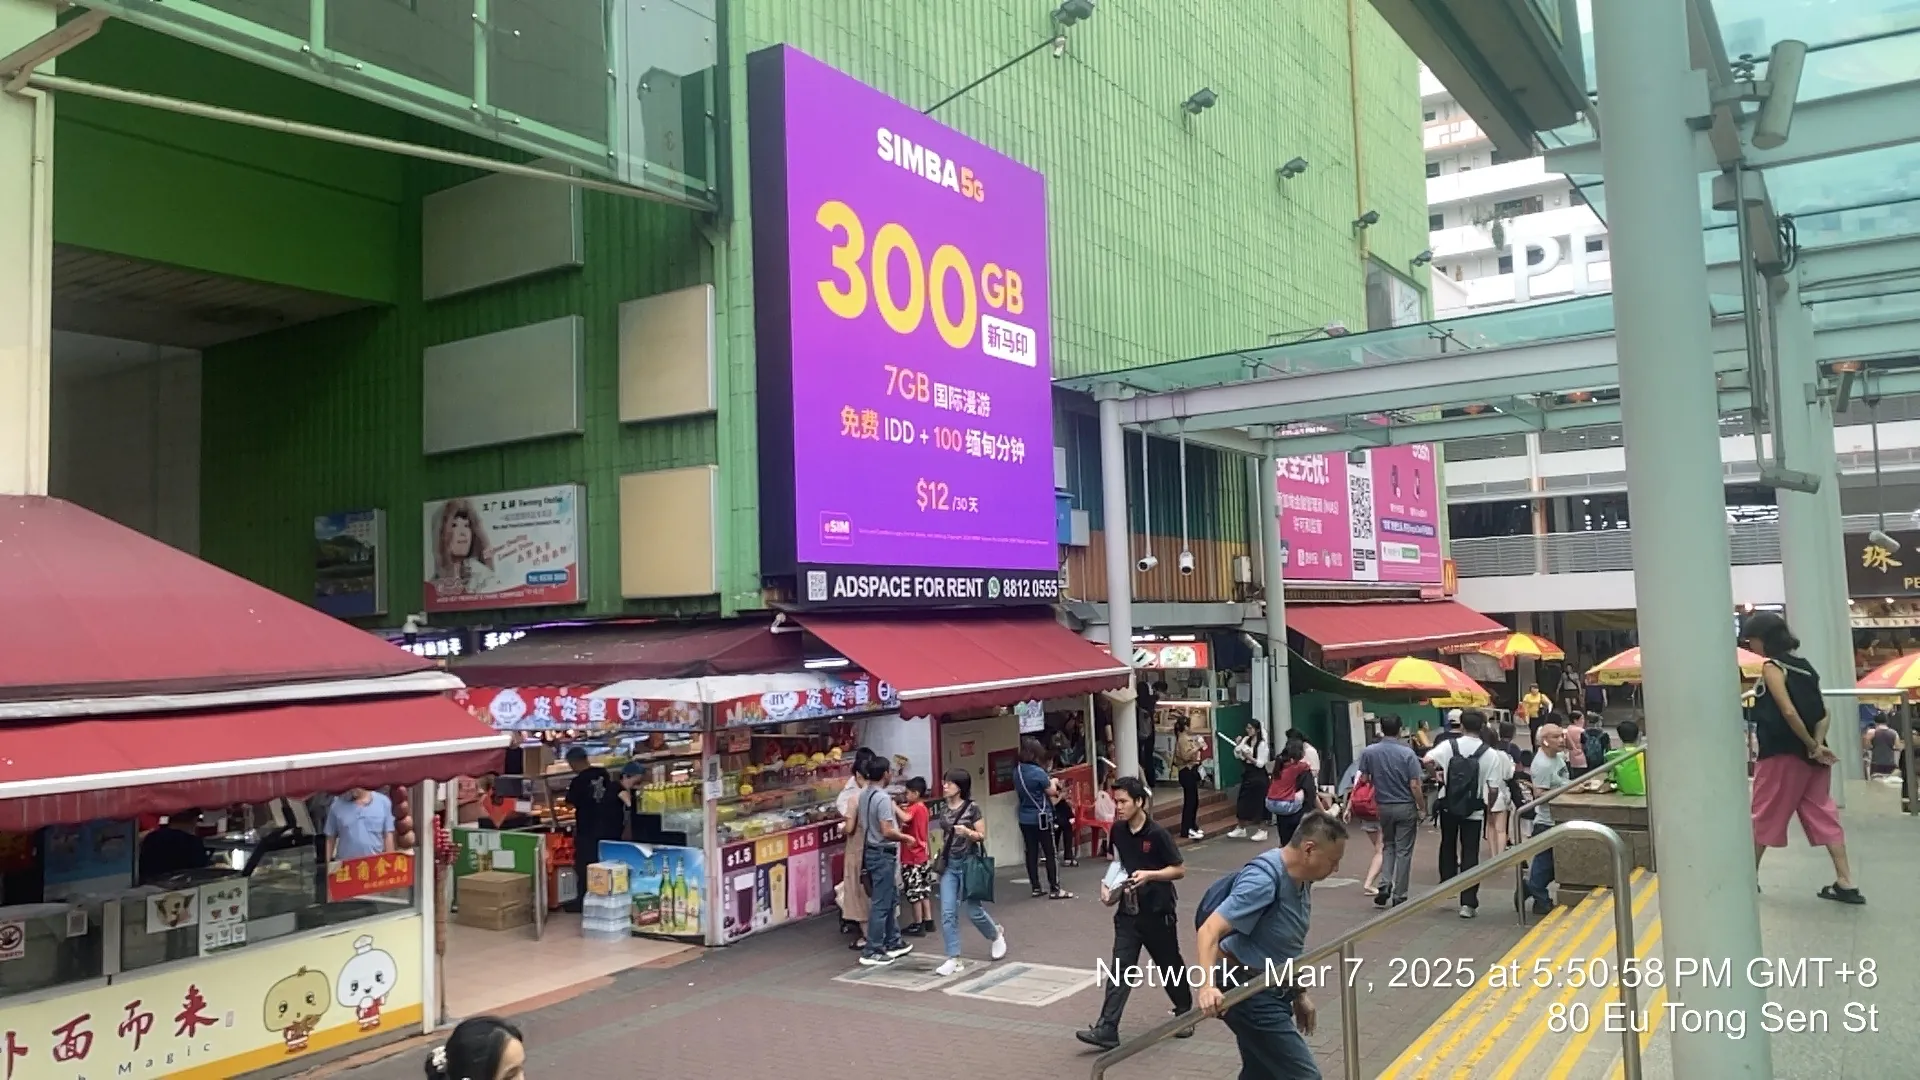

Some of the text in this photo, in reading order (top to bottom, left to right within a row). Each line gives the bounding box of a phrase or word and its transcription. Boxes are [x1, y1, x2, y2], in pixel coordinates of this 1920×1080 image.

[877, 127, 984, 202] SIMBA 5G
[815, 200, 1024, 349] 300 GB
[987, 322, 1029, 357] 新马印
[884, 364, 991, 418] 7GB 国际漫游
[840, 404, 880, 441] 免费
[884, 416, 915, 445] IDD
[933, 426, 963, 452] 100
[965, 428, 1026, 465] 缅甸分钟
[916, 477, 949, 512] $12
[833, 575, 1058, 598] ADSPACE FOR RENT 8812 0555
[727, 847, 751, 867] $1.5
[793, 832, 815, 850] $1.5
